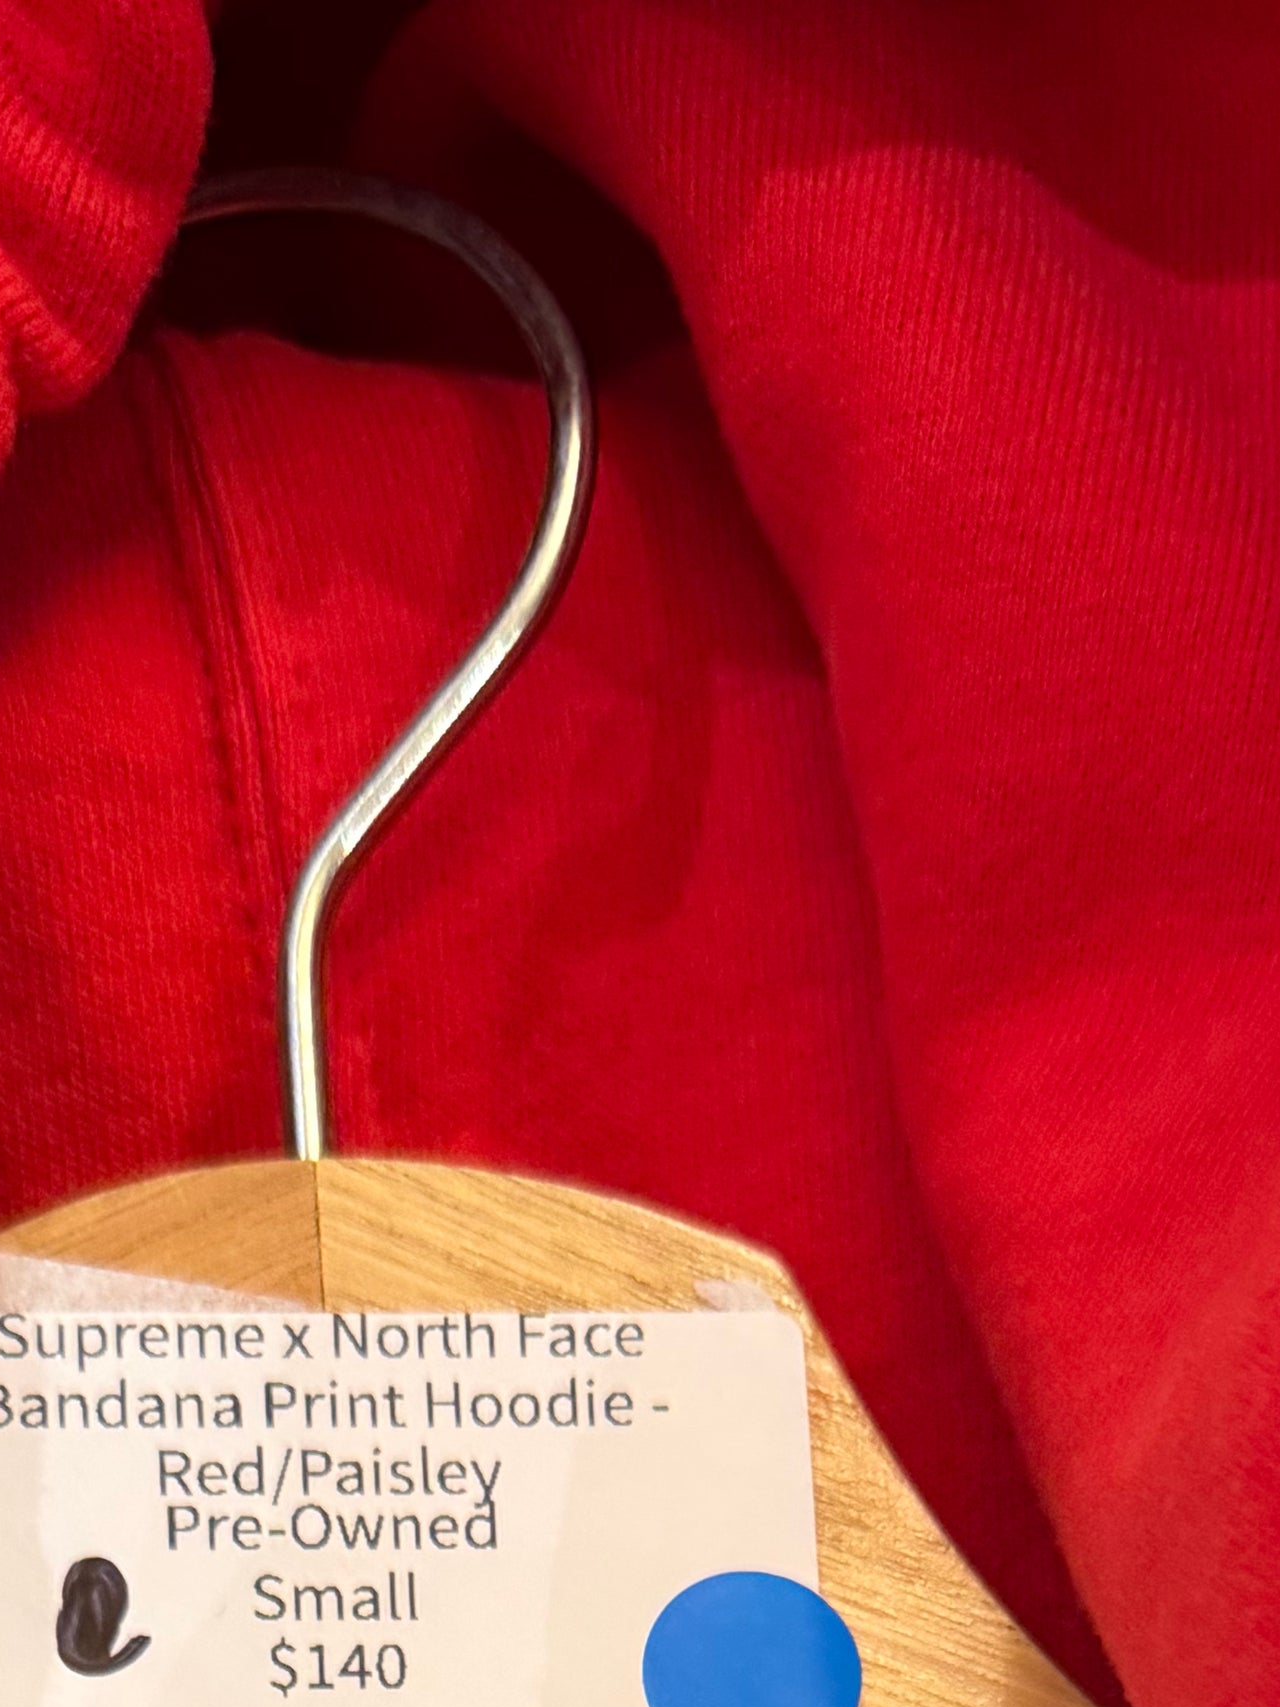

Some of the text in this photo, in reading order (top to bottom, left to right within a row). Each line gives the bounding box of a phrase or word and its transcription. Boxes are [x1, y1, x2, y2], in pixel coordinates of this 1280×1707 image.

[283, 1323, 313, 1358] x
[333, 1313, 496, 1358] North
[520, 1313, 645, 1358] Face
[265, 1379, 407, 1428] Print
[426, 1377, 634, 1428] Hoodie
[158, 1445, 501, 1507] Red/Paisley
[166, 1500, 497, 1550] Pre-Owned
[253, 1571, 418, 1621] Small
[270, 1637, 407, 1698] $140
